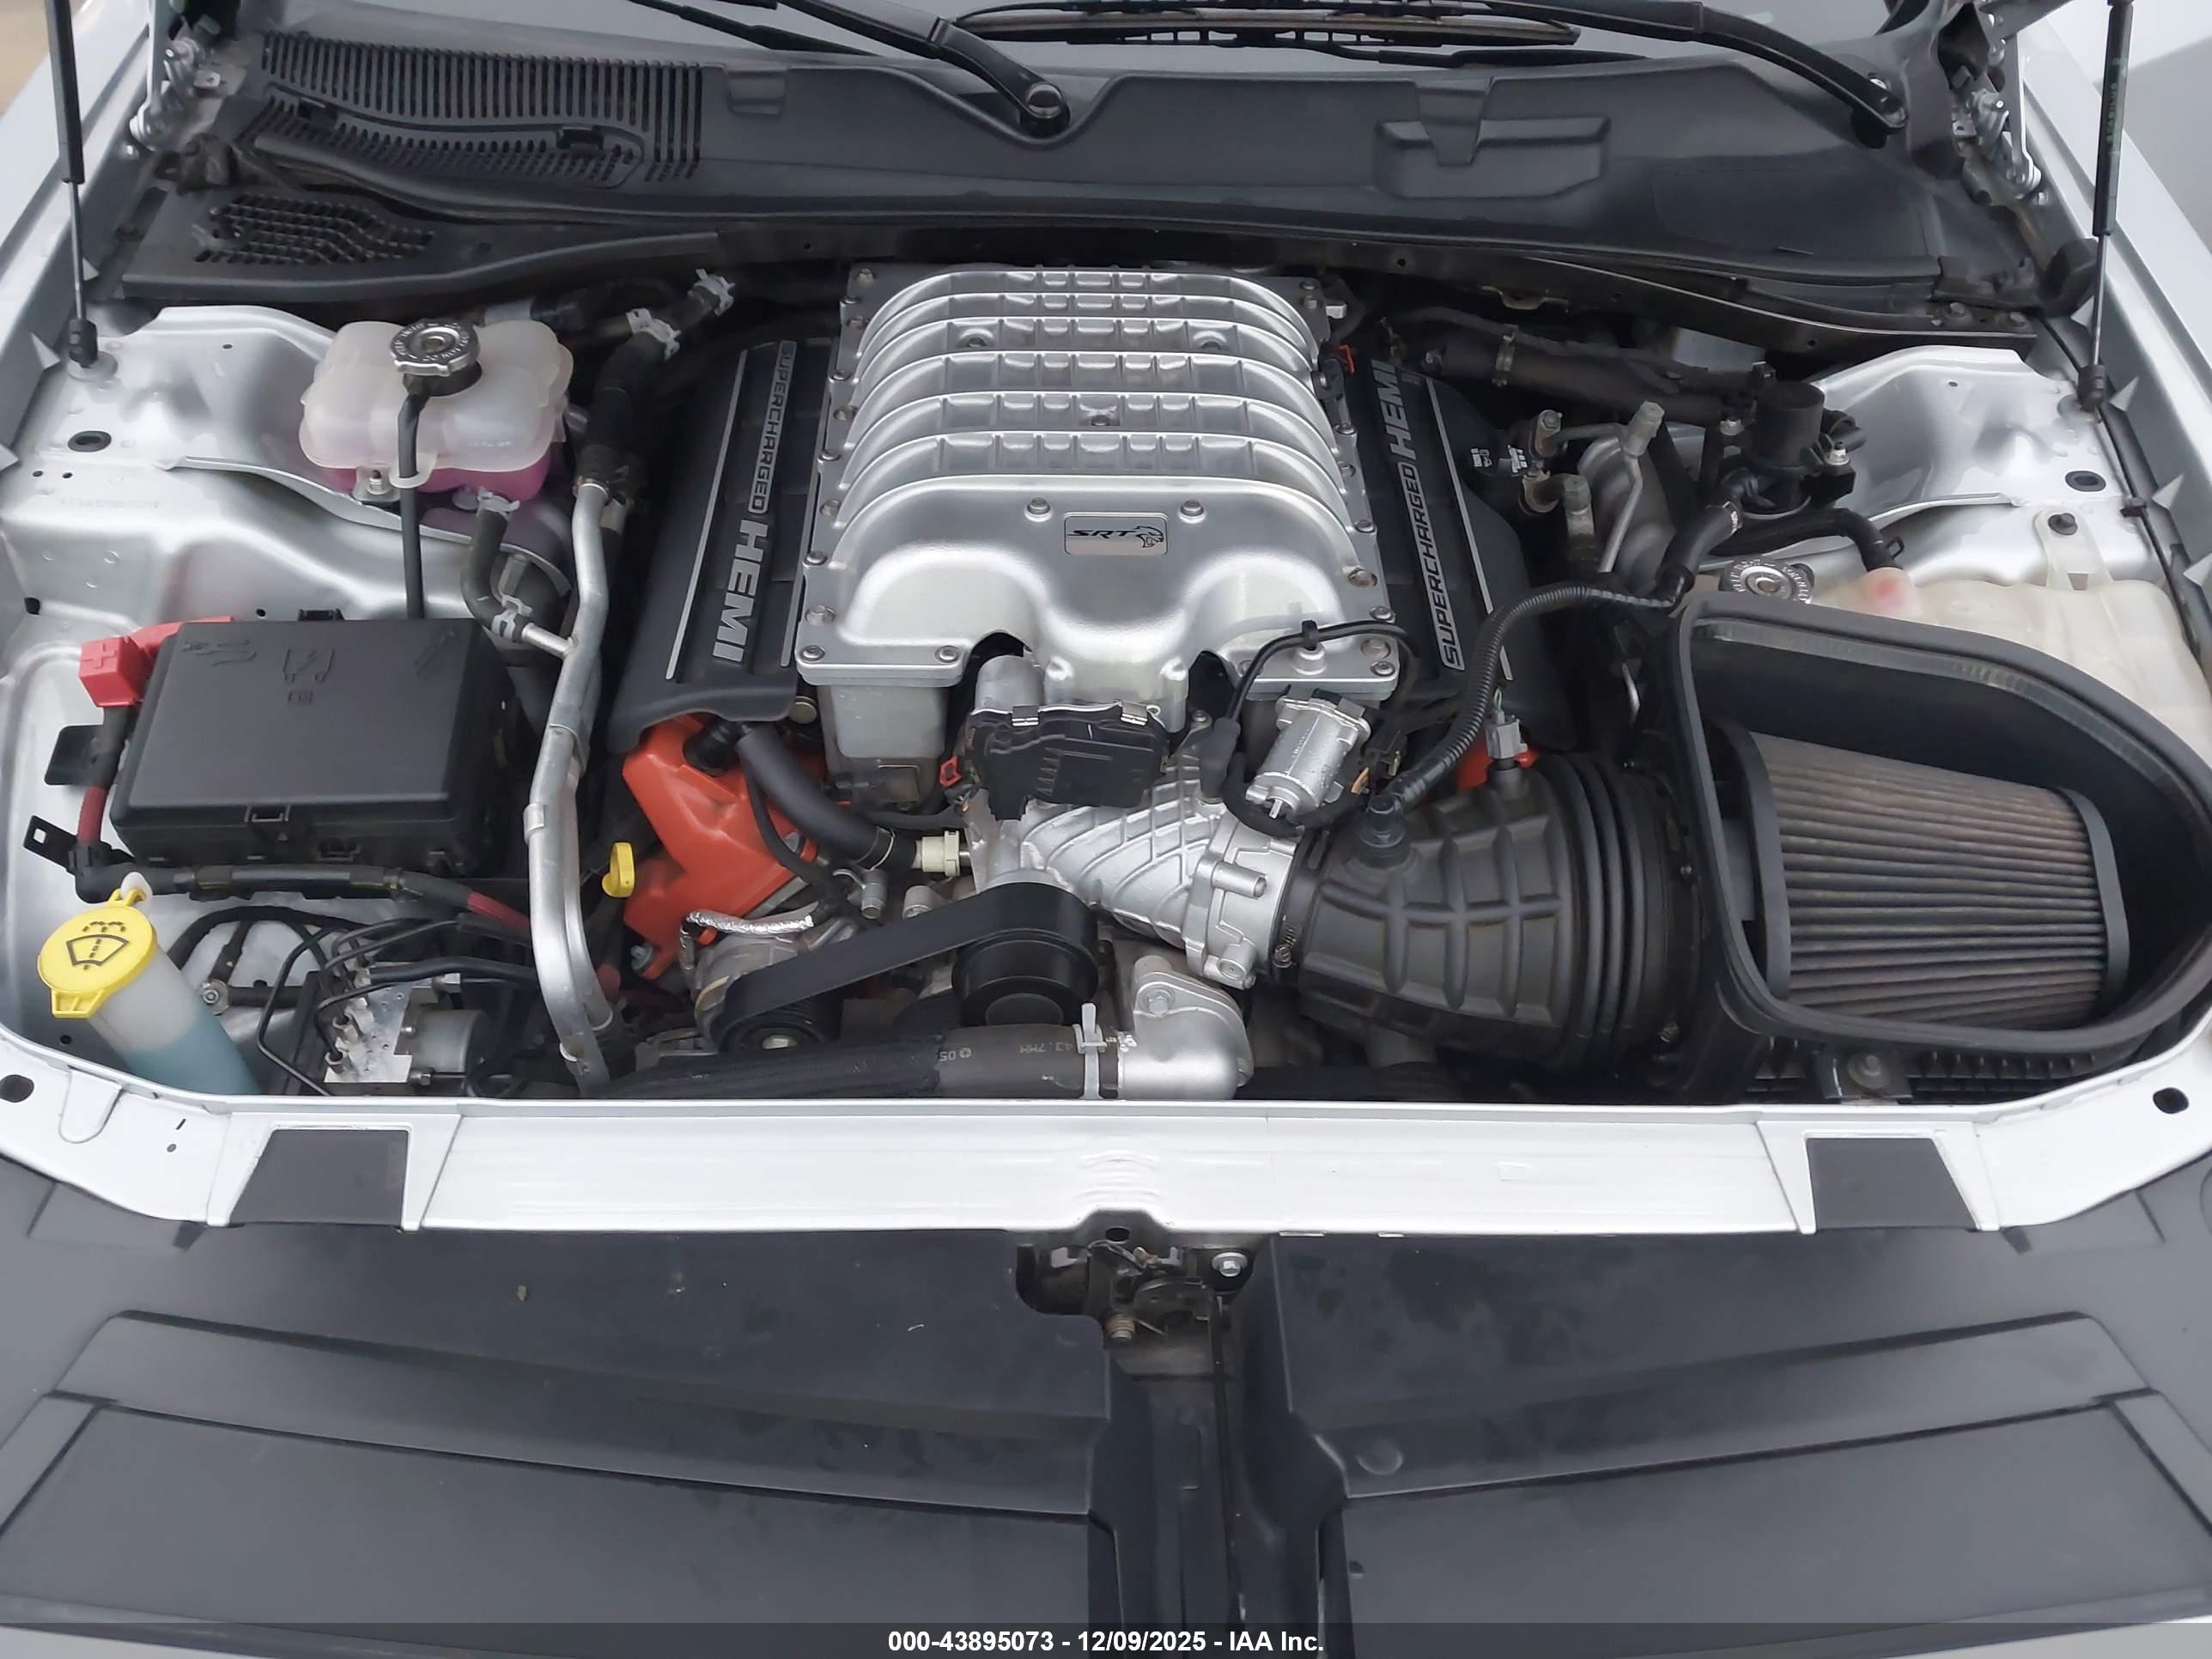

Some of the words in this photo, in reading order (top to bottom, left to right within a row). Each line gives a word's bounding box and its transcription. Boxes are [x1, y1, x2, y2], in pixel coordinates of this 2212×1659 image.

[750, 343, 795, 512] SUPERCHARGED
[1370, 359, 1416, 461] HEMI
[712, 519, 769, 662] HEMI
[1066, 529, 1136, 539] SRT
[1402, 464, 1462, 669] SUPERCHARGED
